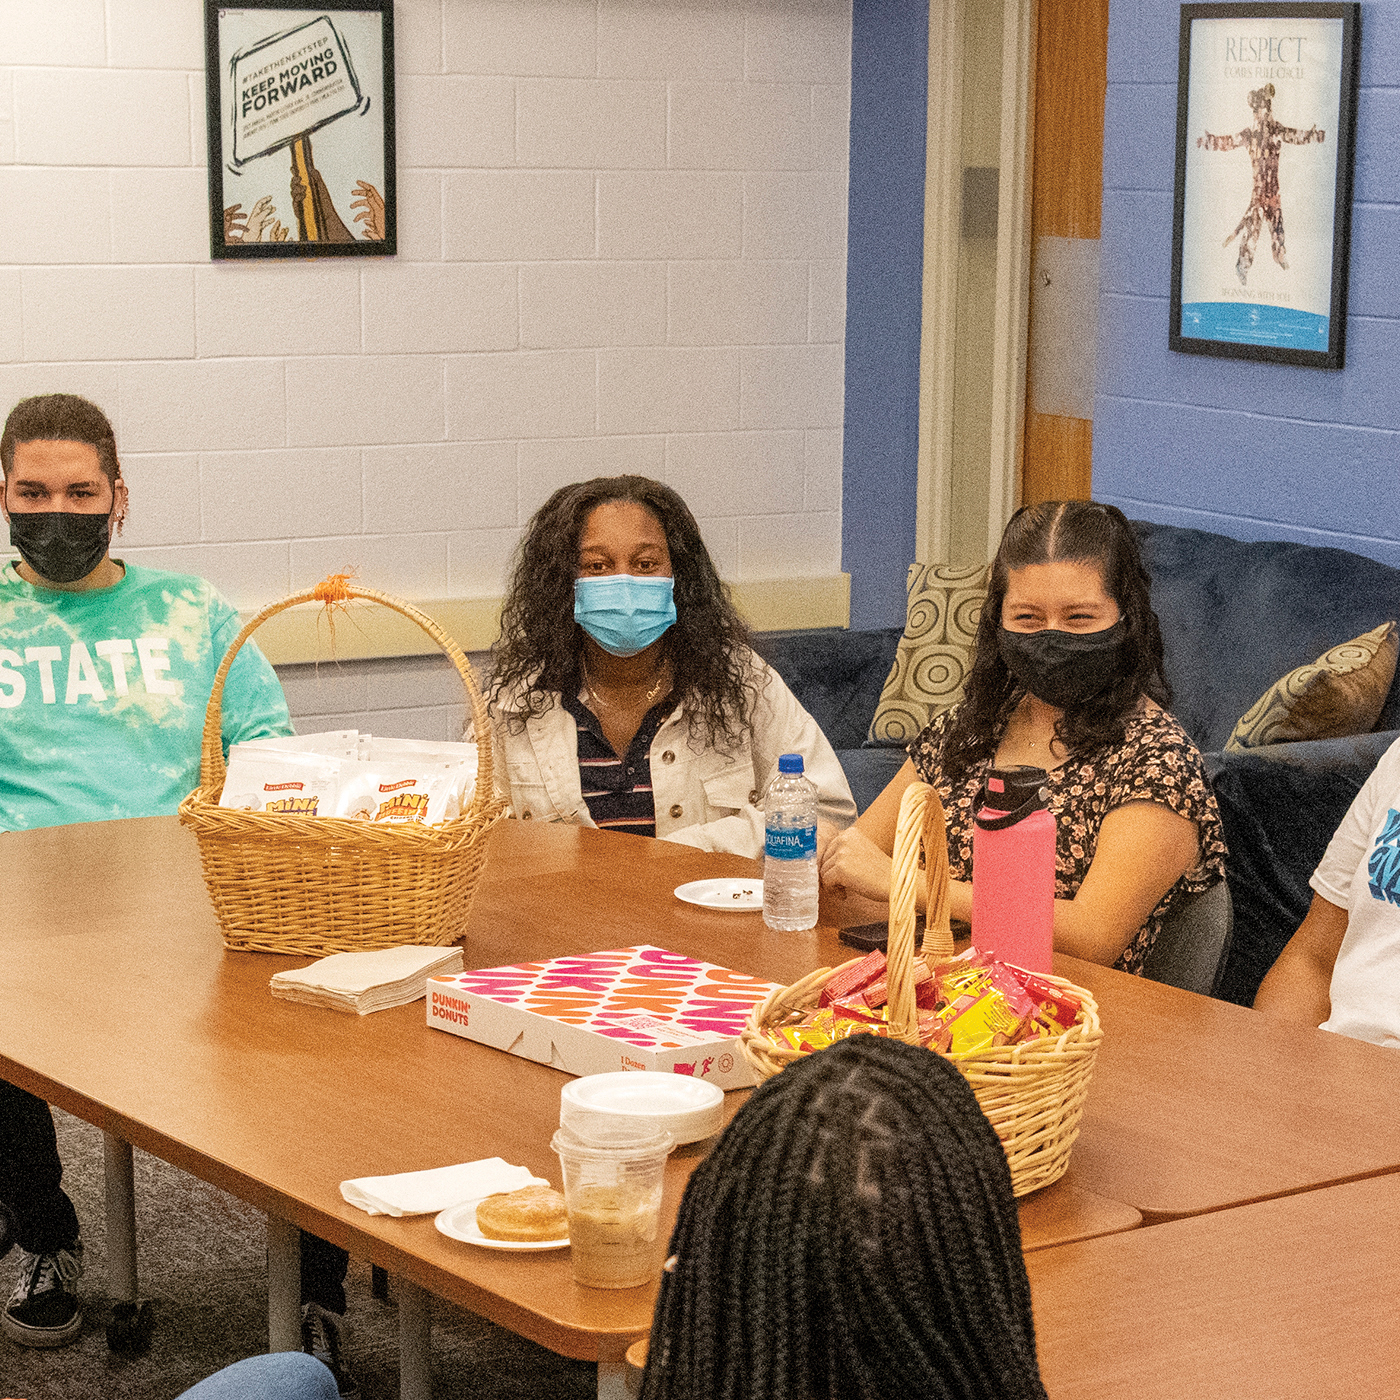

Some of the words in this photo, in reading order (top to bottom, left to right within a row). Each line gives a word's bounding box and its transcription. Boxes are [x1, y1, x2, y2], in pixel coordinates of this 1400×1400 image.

[242, 37, 329, 84] #TAKETHENEXTSTEP
[1226, 37, 1307, 62] RESPECT
[242, 78, 275, 101] KEEP
[279, 48, 334, 83] MOVING
[242, 61, 337, 118] FORWARD
[432, 992, 471, 1014] DUNKIN'
[432, 1005, 469, 1026] DONUTS
[625, 1057, 646, 1071] Dozen
